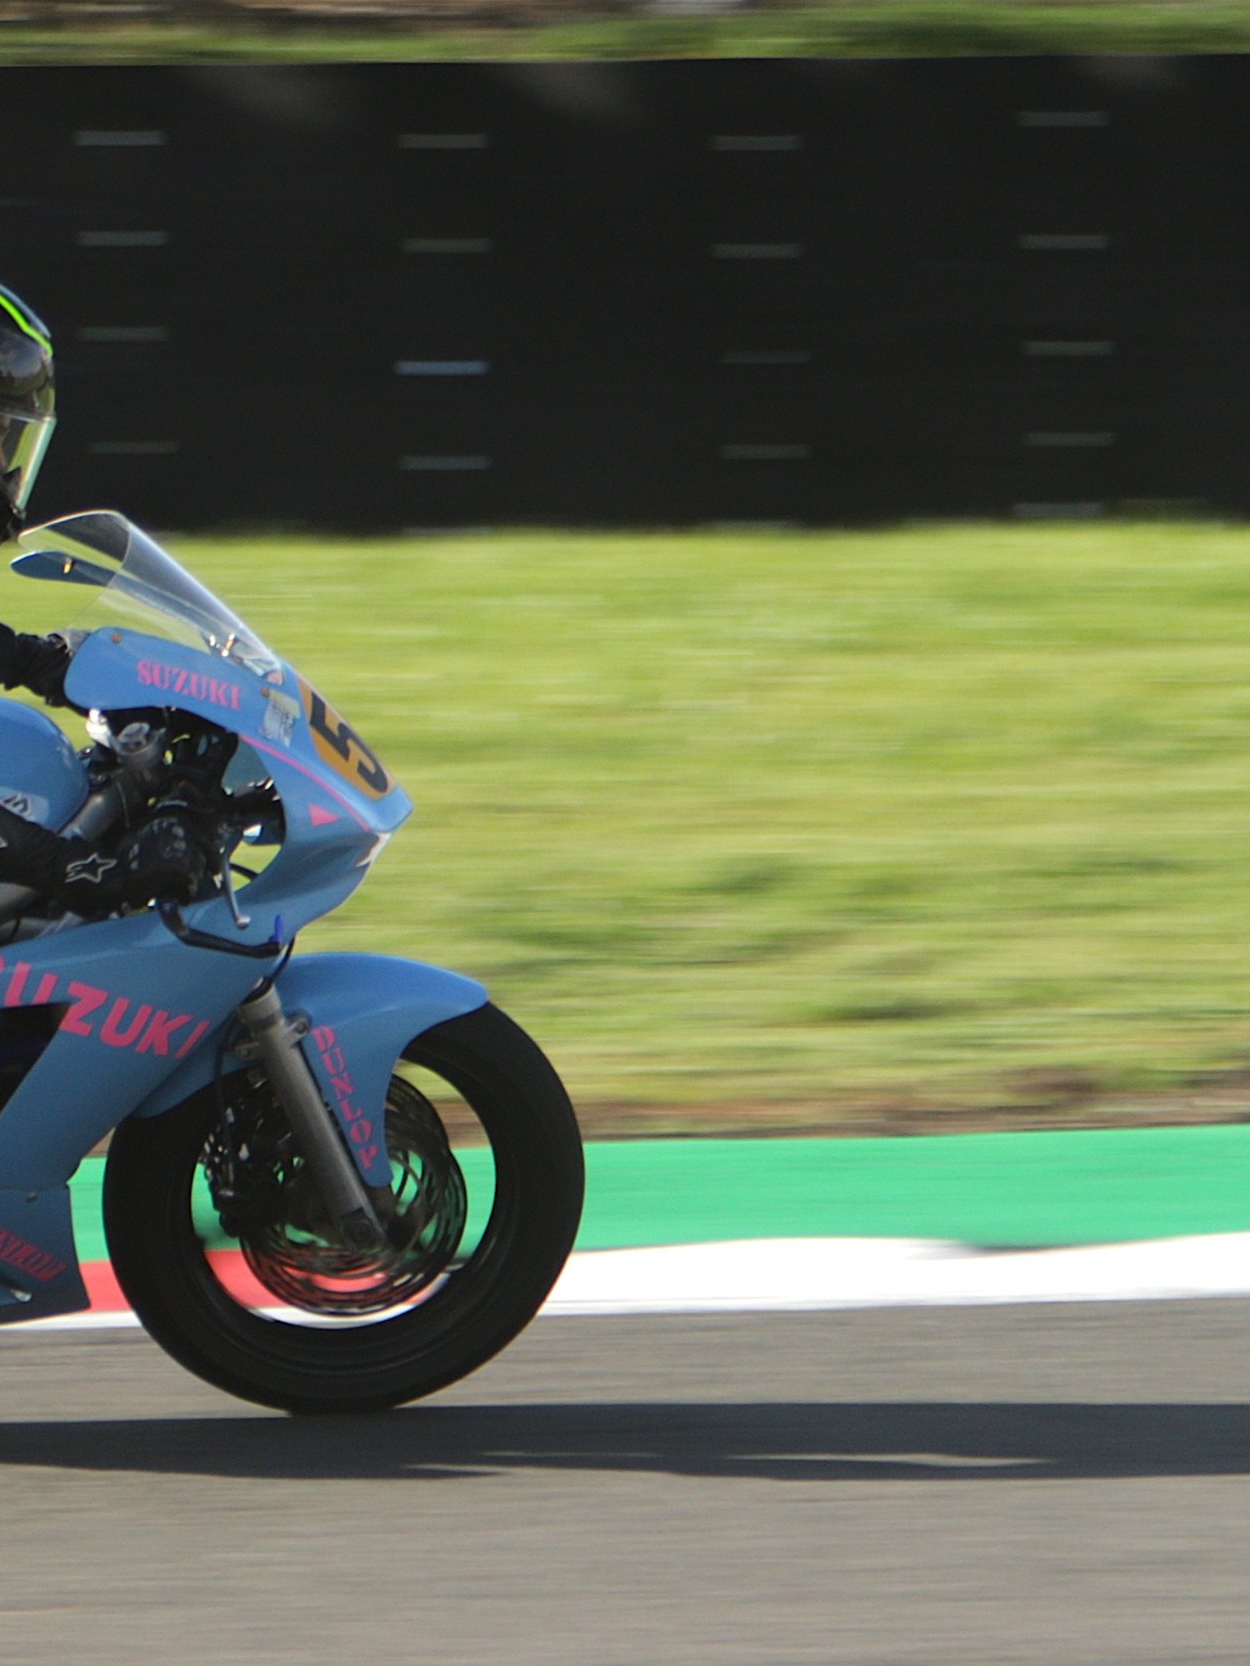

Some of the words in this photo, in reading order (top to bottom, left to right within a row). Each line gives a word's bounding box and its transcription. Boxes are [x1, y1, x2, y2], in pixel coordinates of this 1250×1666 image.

[137, 660, 242, 710] SUZUKI
[309, 692, 388, 792] 5
[312, 1025, 378, 1169] DUNLOP
